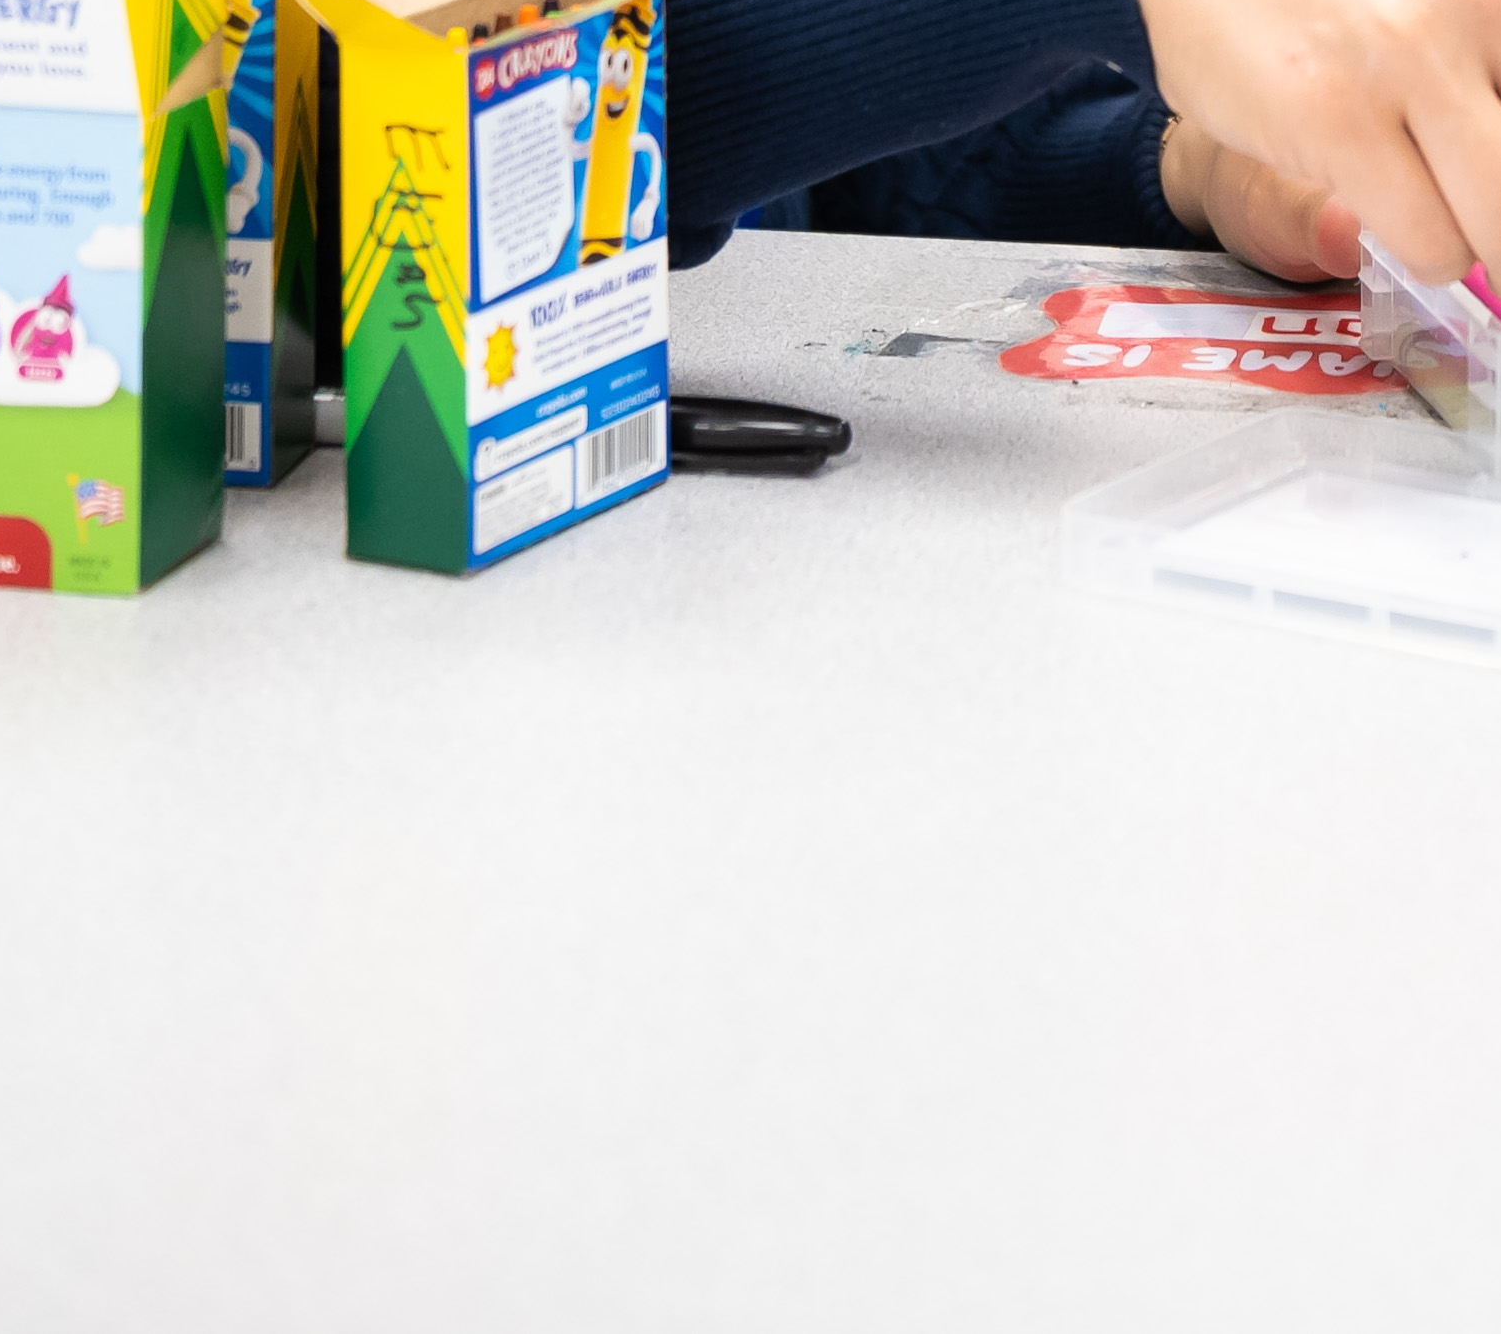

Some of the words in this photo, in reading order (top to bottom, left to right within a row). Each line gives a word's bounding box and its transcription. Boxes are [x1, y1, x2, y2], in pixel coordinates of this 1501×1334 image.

[49, 40, 87, 59] and
[498, 30, 578, 90] CRAYONS
[1061, 344, 1152, 367] IS
